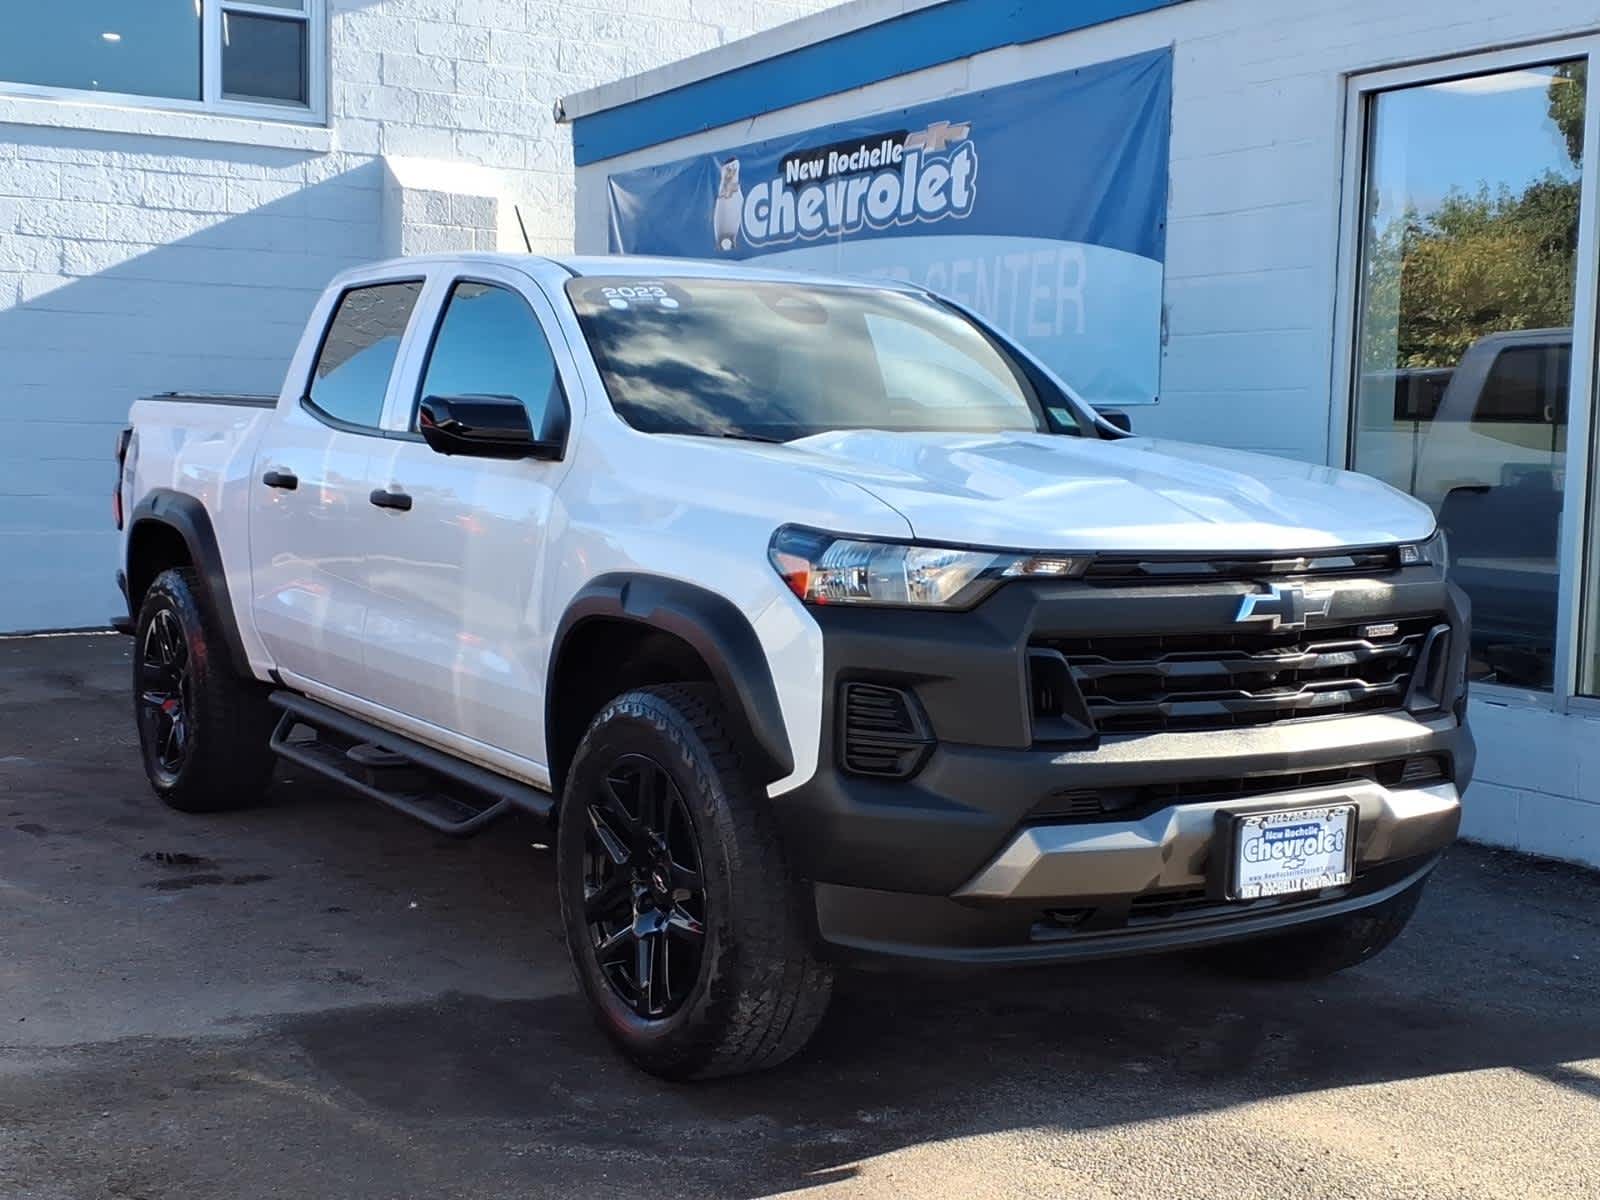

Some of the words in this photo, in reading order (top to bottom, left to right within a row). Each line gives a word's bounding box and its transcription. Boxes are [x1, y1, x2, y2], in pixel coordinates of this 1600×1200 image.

[785, 158, 825, 184] New
[828, 139, 903, 176] Rochelle
[743, 147, 972, 239] Chevrolet
[601, 286, 668, 299] 2023
[1243, 827, 1345, 863] Chevrolet
[1265, 830, 1283, 841] New
[1284, 826, 1319, 839] Rochelle
